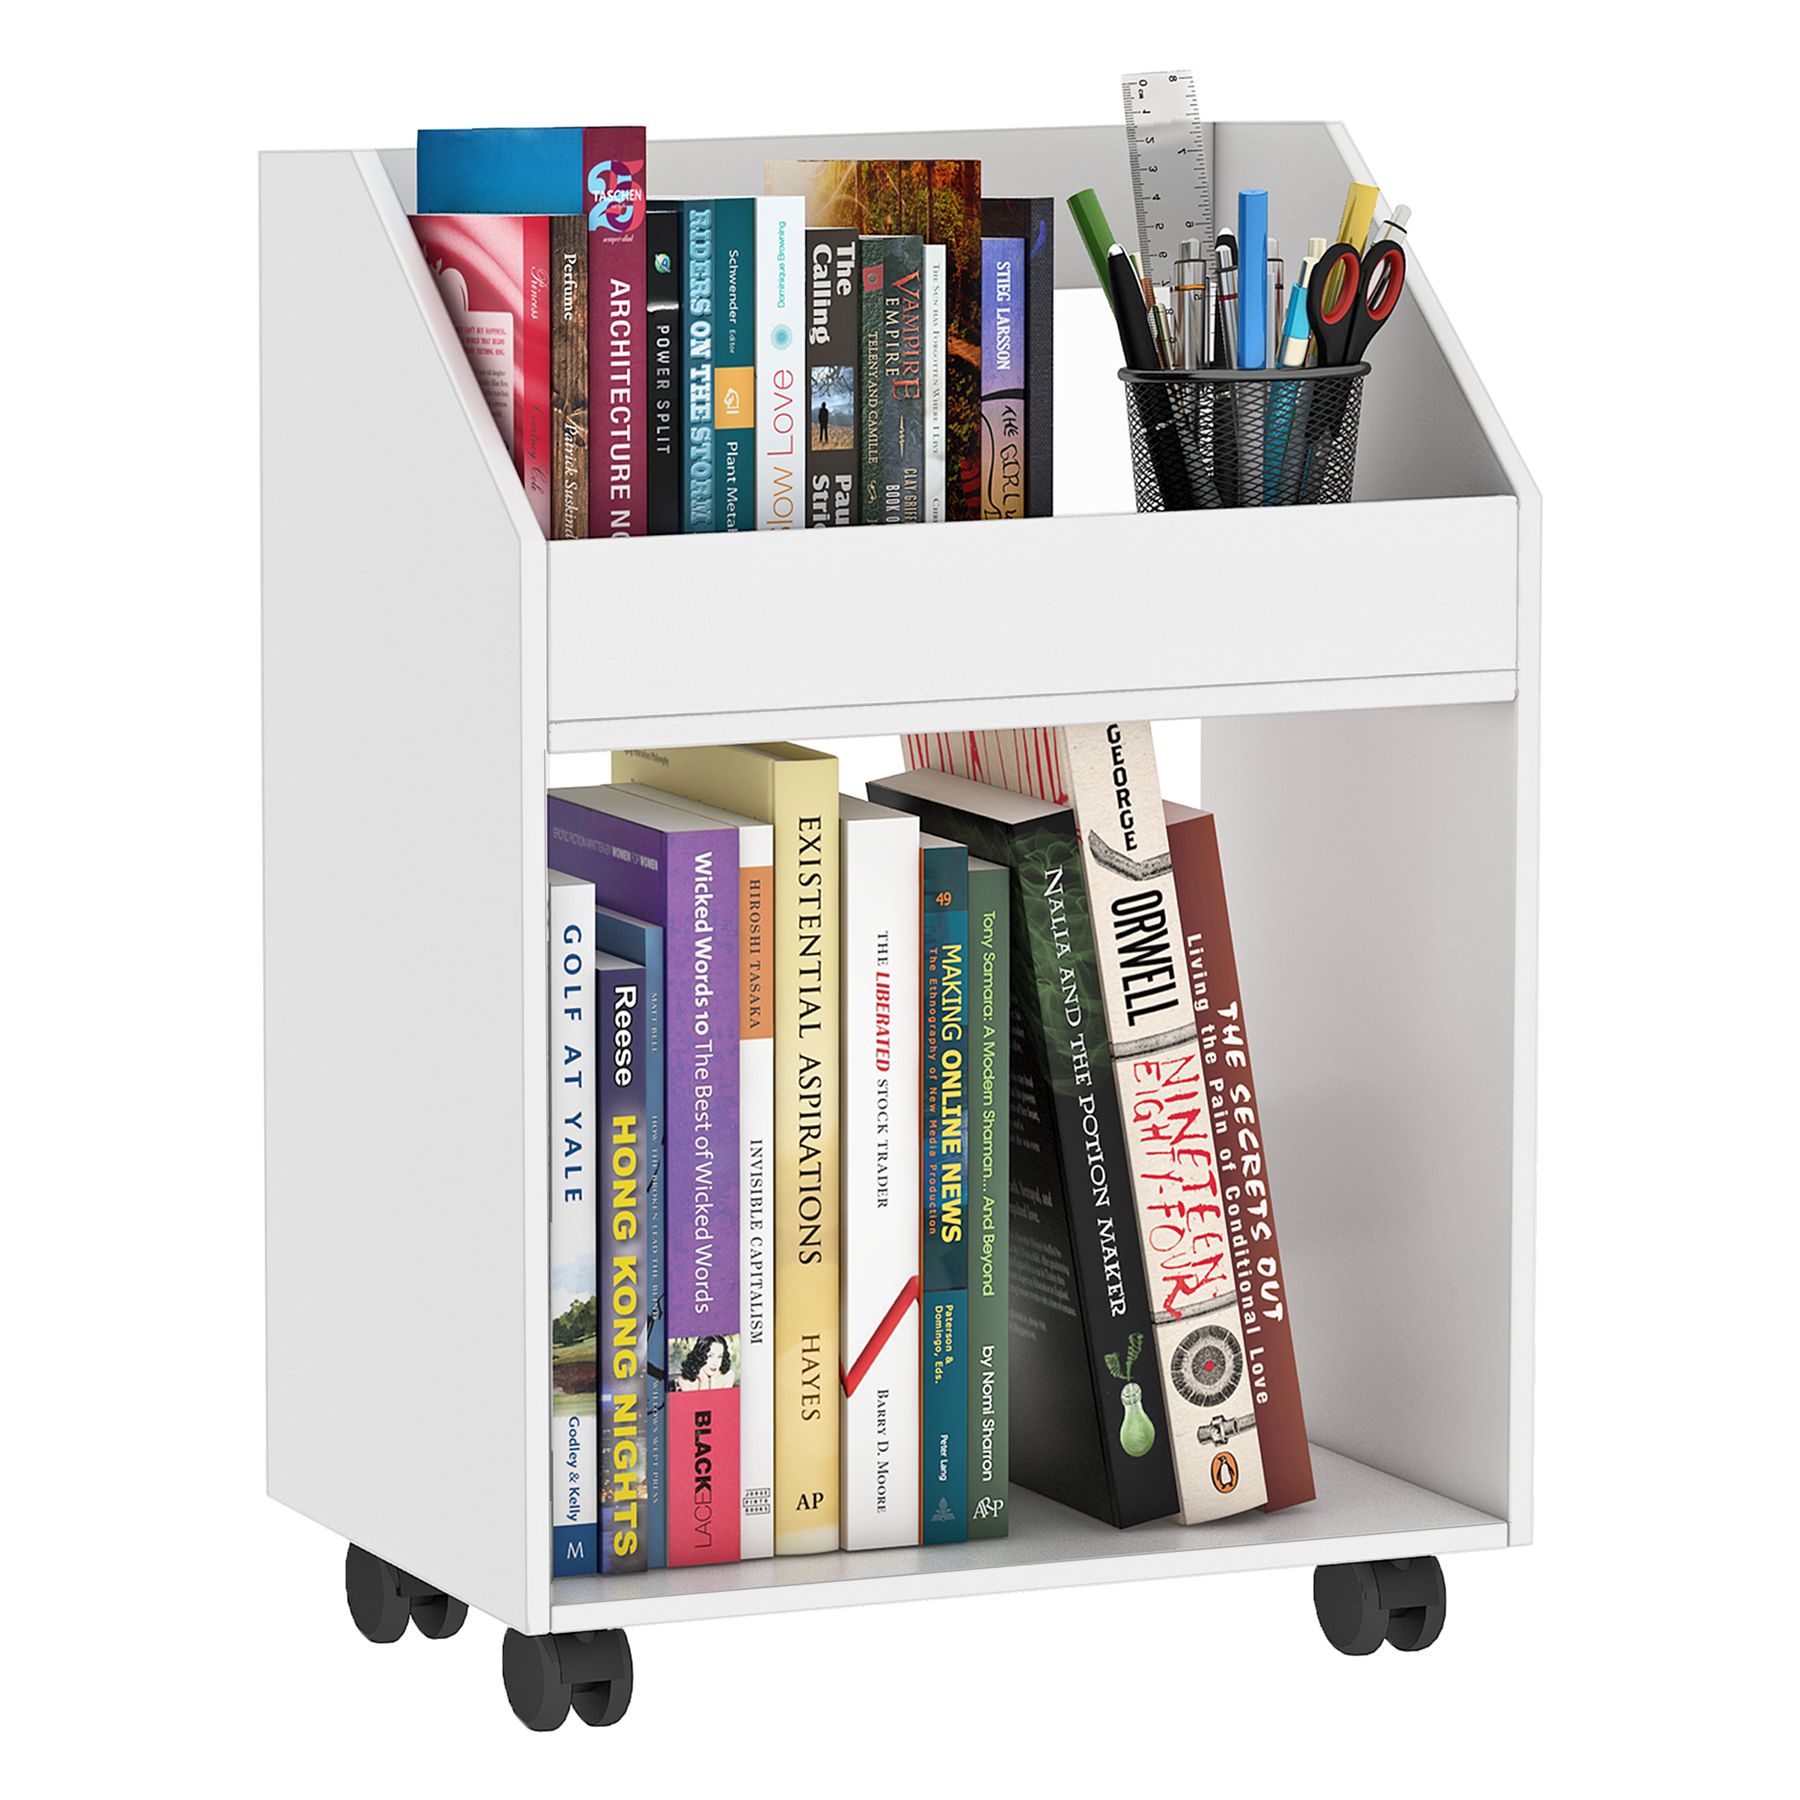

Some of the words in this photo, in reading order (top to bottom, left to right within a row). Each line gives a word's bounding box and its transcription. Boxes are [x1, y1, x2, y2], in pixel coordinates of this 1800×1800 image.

[594, 188, 642, 202] TASCHEN
[689, 209, 712, 316] RIDERS
[777, 221, 786, 261] Browning
[837, 242, 855, 295] The
[530, 266, 549, 320] Princess
[563, 253, 578, 320] Perfume
[729, 250, 739, 324] Schwender
[777, 262, 786, 308] Dominique
[809, 244, 832, 345] Calling
[996, 261, 1011, 302] STIEG
[656, 325, 670, 389] POWER
[690, 320, 711, 360] ON
[729, 329, 739, 354] Editor
[868, 331, 878, 377] TELENY
[886, 298, 899, 376] EMPIRE
[891, 269, 920, 400] VAMPIRE
[996, 308, 1011, 370] LARSSON
[610, 279, 631, 500] ARCHITECTURE
[690, 364, 712, 422] THE
[767, 369, 793, 455] Love
[868, 378, 878, 408] AND
[563, 423, 579, 476] Patrick
[656, 400, 670, 454] SPLIT
[868, 410, 878, 464] CAMILLE
[1001, 405, 1019, 437] THE
[690, 426, 712, 524] STORM
[727, 441, 738, 483] Plant
[904, 467, 917, 490] CLAY
[1000, 444, 1020, 507] GIRL
[563, 479, 579, 540] Suskind
[886, 484, 900, 512] BOOK
[1106, 723, 1137, 851] GEORGE
[694, 852, 713, 932] Wicked
[750, 879, 760, 953] HIROSHI
[936, 891, 951, 906] 49
[1044, 864, 1071, 959] NALIA
[798, 815, 821, 1038] EXISTENTIAL
[877, 931, 889, 966] THE
[981, 911, 995, 948] Tony
[563, 925, 582, 1021] GOLF
[694, 937, 713, 1008] Words
[929, 948, 937, 971] The
[982, 953, 995, 1022] Samara:
[1111, 889, 1179, 1027] ORWELL
[1187, 934, 1209, 1011] Living
[750, 960, 760, 1029] TASAKA
[876, 971, 890, 1072] LIBERATED
[928, 978, 937, 1060] Ethnography
[942, 944, 962, 1041] MAKING
[1059, 966, 1082, 1027] AND
[614, 984, 637, 1087] Reese
[694, 1012, 709, 1035] 10
[983, 1026, 995, 1038] A
[1200, 1024, 1217, 1064] the
[1217, 1001, 1246, 1068] THE
[564, 1045, 582, 1088] AT
[695, 1040, 713, 1080] The
[929, 1066, 937, 1083] of
[982, 1041, 995, 1106] Modern
[1070, 1034, 1092, 1086] THE
[695, 1085, 712, 1131] Best
[877, 1078, 889, 1134] STOCK
[929, 1087, 937, 1113] New
[942, 1049, 962, 1154] ONLINE
[1209, 1078, 1227, 1134] Pain
[564, 1111, 582, 1202] YALE
[695, 1136, 713, 1159] of
[798, 1054, 822, 1264] ASPIRATIONS
[929, 1119, 937, 1157] Media
[982, 1110, 995, 1192] Shaman...
[1079, 1093, 1110, 1208] POTION
[1219, 1148, 1236, 1171] of
[1230, 1084, 1272, 1241] SECRETS
[612, 1115, 637, 1241] HONG
[695, 1160, 713, 1239] Wicked
[750, 1139, 762, 1230] INVISIBLE
[877, 1140, 889, 1209] TRADER
[929, 1165, 937, 1235] Production
[1133, 1060, 1197, 1320] EIGHTY-FOUR
[1161, 1054, 1227, 1290] NINETEEN
[942, 1163, 962, 1243] NEWS
[982, 1196, 995, 1230] And
[695, 1242, 713, 1313] Words
[750, 1236, 763, 1344] CAPITALISM
[981, 1234, 995, 1296] Beyond
[1097, 1217, 1127, 1317] MAKER
[1225, 1186, 1261, 1334] Conditional
[1257, 1257, 1283, 1322] OUT
[613, 1255, 637, 1379] KONG
[933, 1306, 943, 1356] Domingo,
[945, 1304, 954, 1352] Paterson
[801, 1334, 820, 1421] HAYES
[935, 1361, 943, 1383] Eds.
[945, 1355, 954, 1365] &
[980, 1345, 995, 1367] by
[1249, 1346, 1269, 1404] Love
[877, 1389, 889, 1435] BARRY
[982, 1373, 995, 1414] Nomi
[566, 1416, 580, 1469] Godley
[694, 1410, 711, 1493] BLACK
[877, 1441, 889, 1456] D.
[938, 1460, 948, 1481] Lang
[939, 1434, 948, 1457] Peter
[982, 1418, 995, 1482] Sharron
[566, 1486, 580, 1521] Kelly
[568, 1472, 580, 1483] &
[613, 1394, 638, 1556] NIGHTS
[796, 1492, 824, 1511] AP
[877, 1461, 889, 1513] MOORE
[567, 1542, 584, 1559] M
